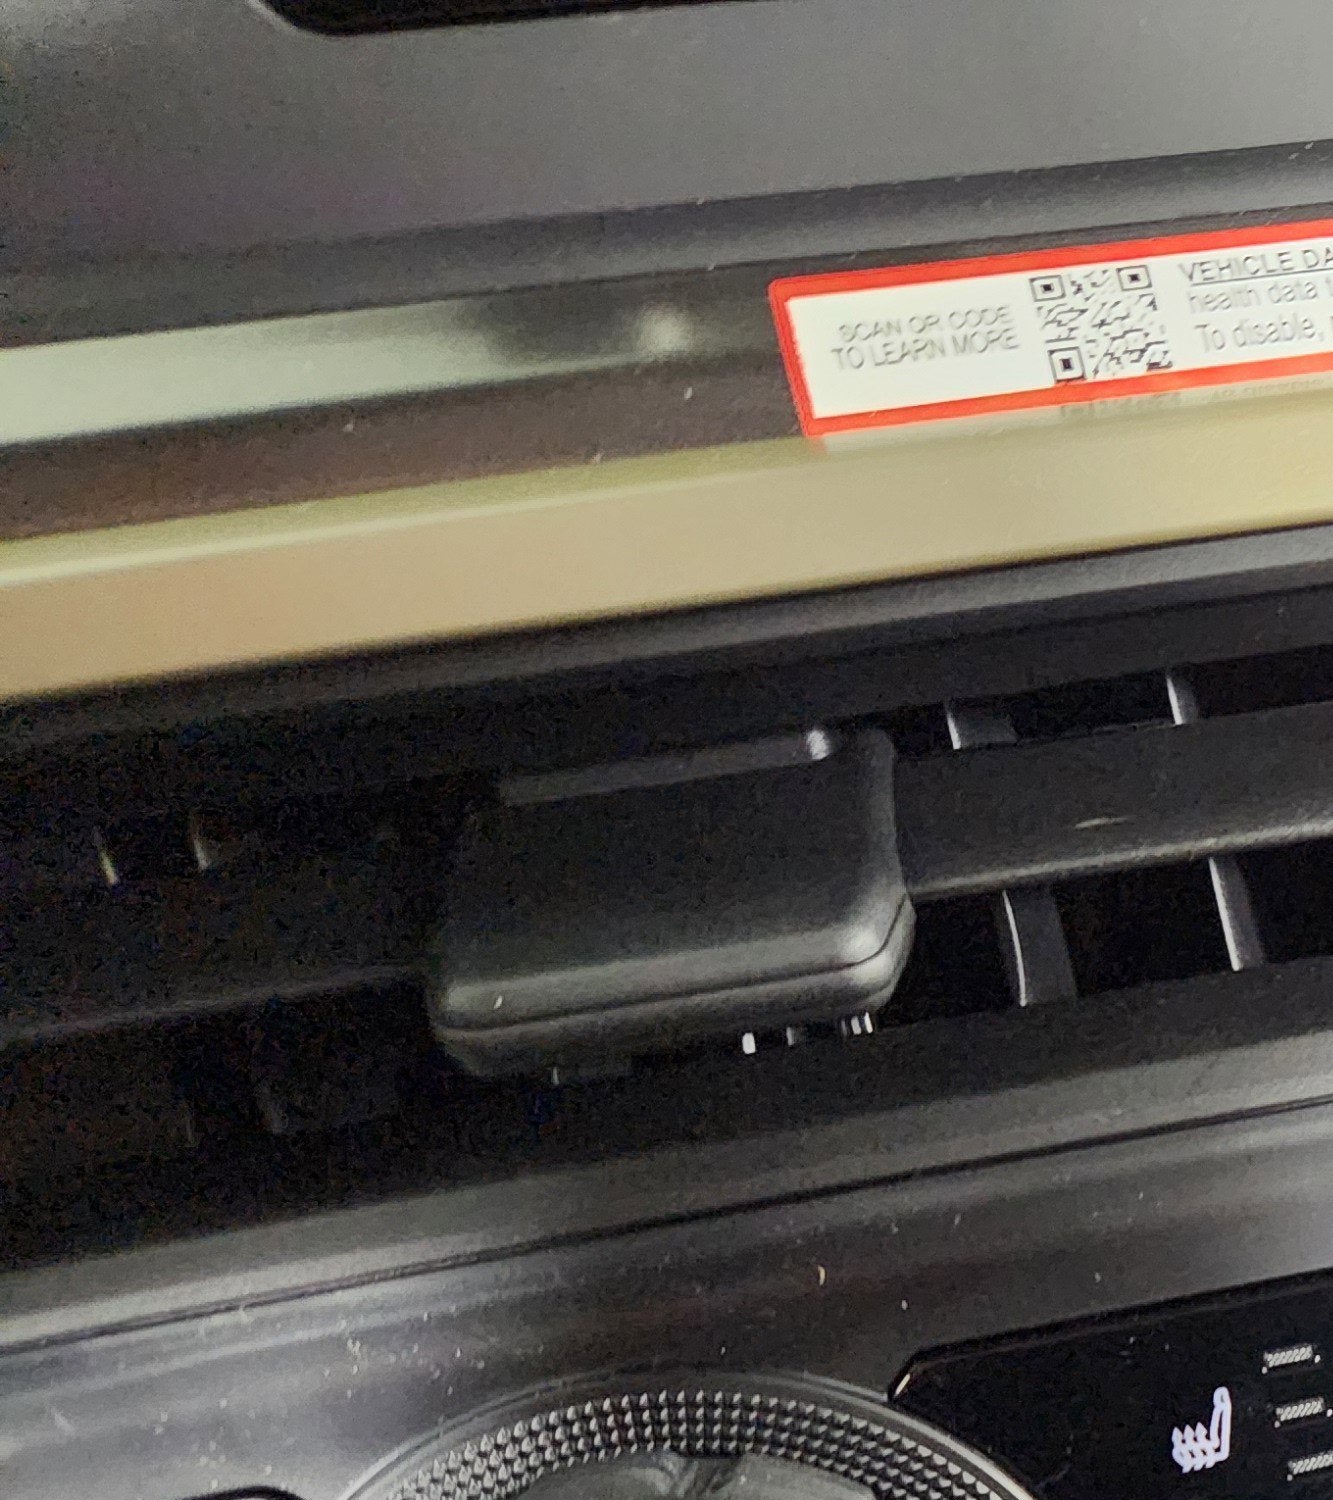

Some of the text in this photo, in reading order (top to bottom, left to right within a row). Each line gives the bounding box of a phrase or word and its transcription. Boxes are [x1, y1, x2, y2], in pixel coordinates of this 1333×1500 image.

[1178, 250, 1295, 282] VEHICLE
[1186, 288, 1262, 314] health
[1267, 277, 1319, 305] data
[839, 319, 901, 342] SCAN
[949, 305, 1013, 330] CODE
[1194, 323, 1227, 351] To
[1232, 311, 1325, 347] disable,
[831, 327, 1020, 370] TO LEARN MORE
